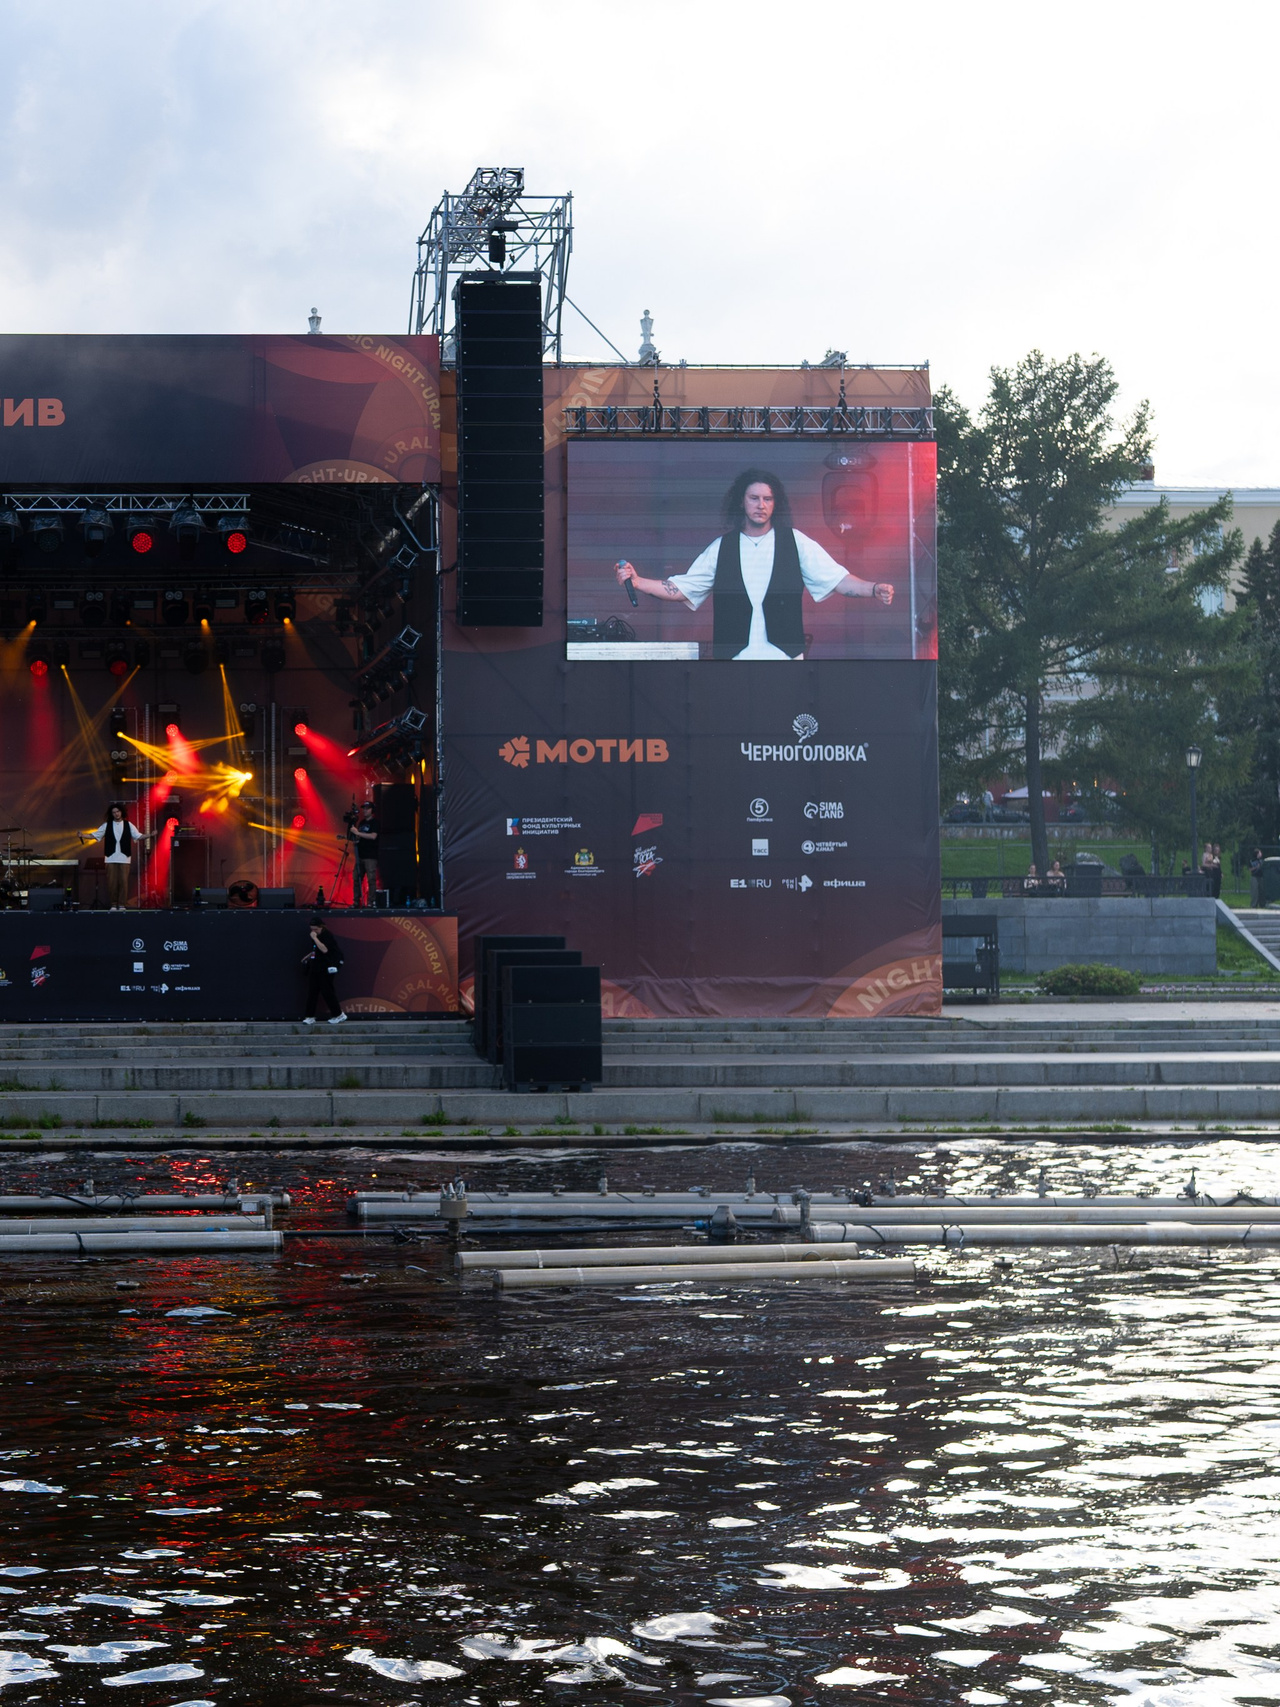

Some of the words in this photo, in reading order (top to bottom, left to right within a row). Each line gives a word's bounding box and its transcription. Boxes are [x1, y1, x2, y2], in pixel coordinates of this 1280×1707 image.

[375, 344, 425, 384] NIGHT
[384, 436, 433, 465] URAL
[536, 738, 670, 764] МОТИВ
[819, 802, 843, 810] SIMA
[819, 811, 844, 819] LAND
[823, 878, 866, 888] афиша
[398, 979, 433, 1001] URAL
